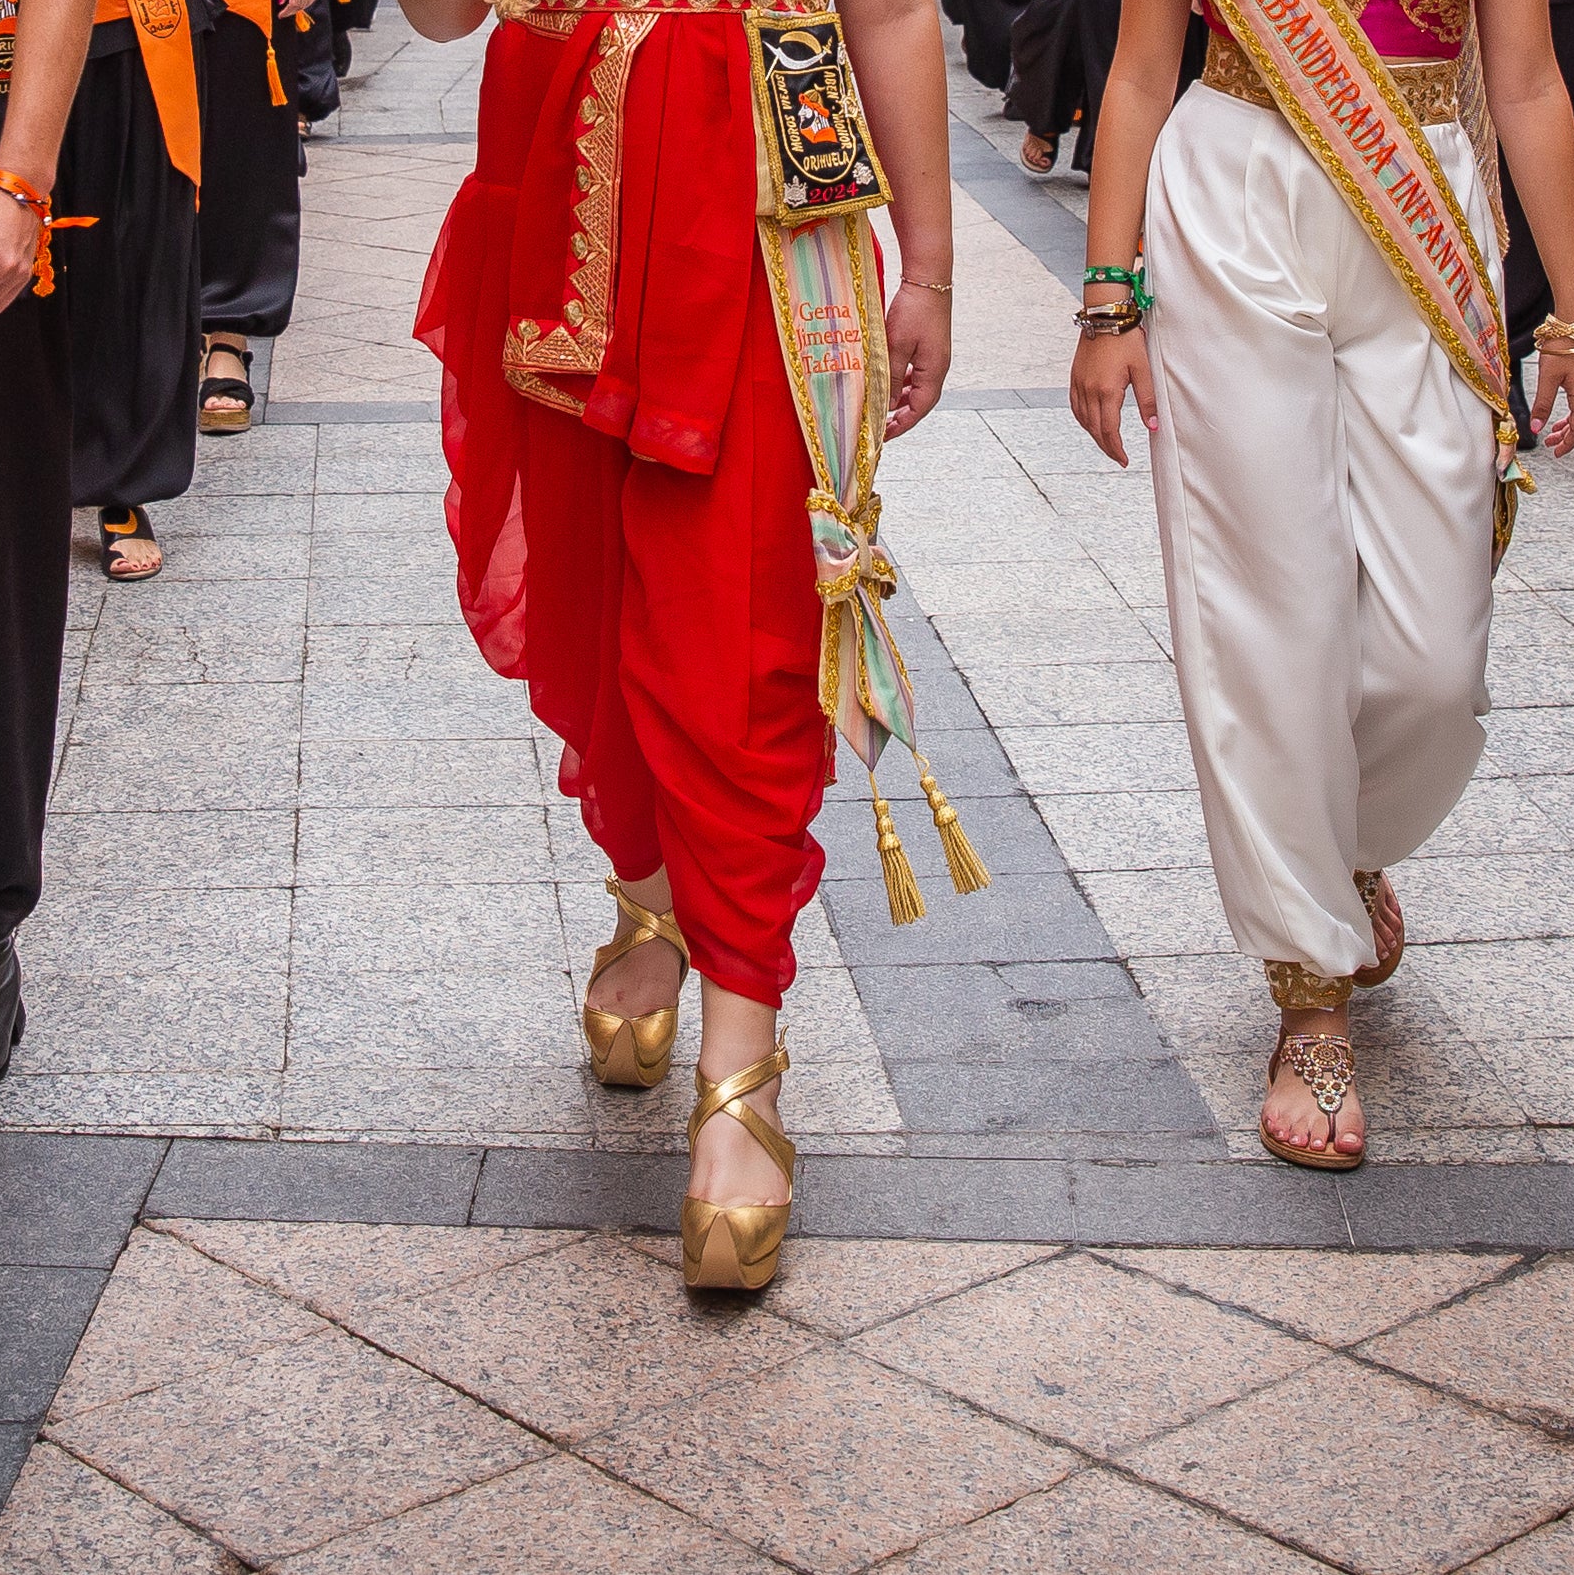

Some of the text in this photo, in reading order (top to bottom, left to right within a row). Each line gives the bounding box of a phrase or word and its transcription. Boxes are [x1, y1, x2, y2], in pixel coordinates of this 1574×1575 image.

[823, 70, 840, 103] ABEN
[775, 74, 805, 153] MOROS VIEJOS
[831, 113, 853, 150] MOHOR
[803, 151, 851, 172] ORIHUELA
[808, 182, 859, 205] 2024
[799, 302, 851, 322] Gema
[795, 329, 862, 353] Jimenez
[801, 351, 862, 375] Tafalla
